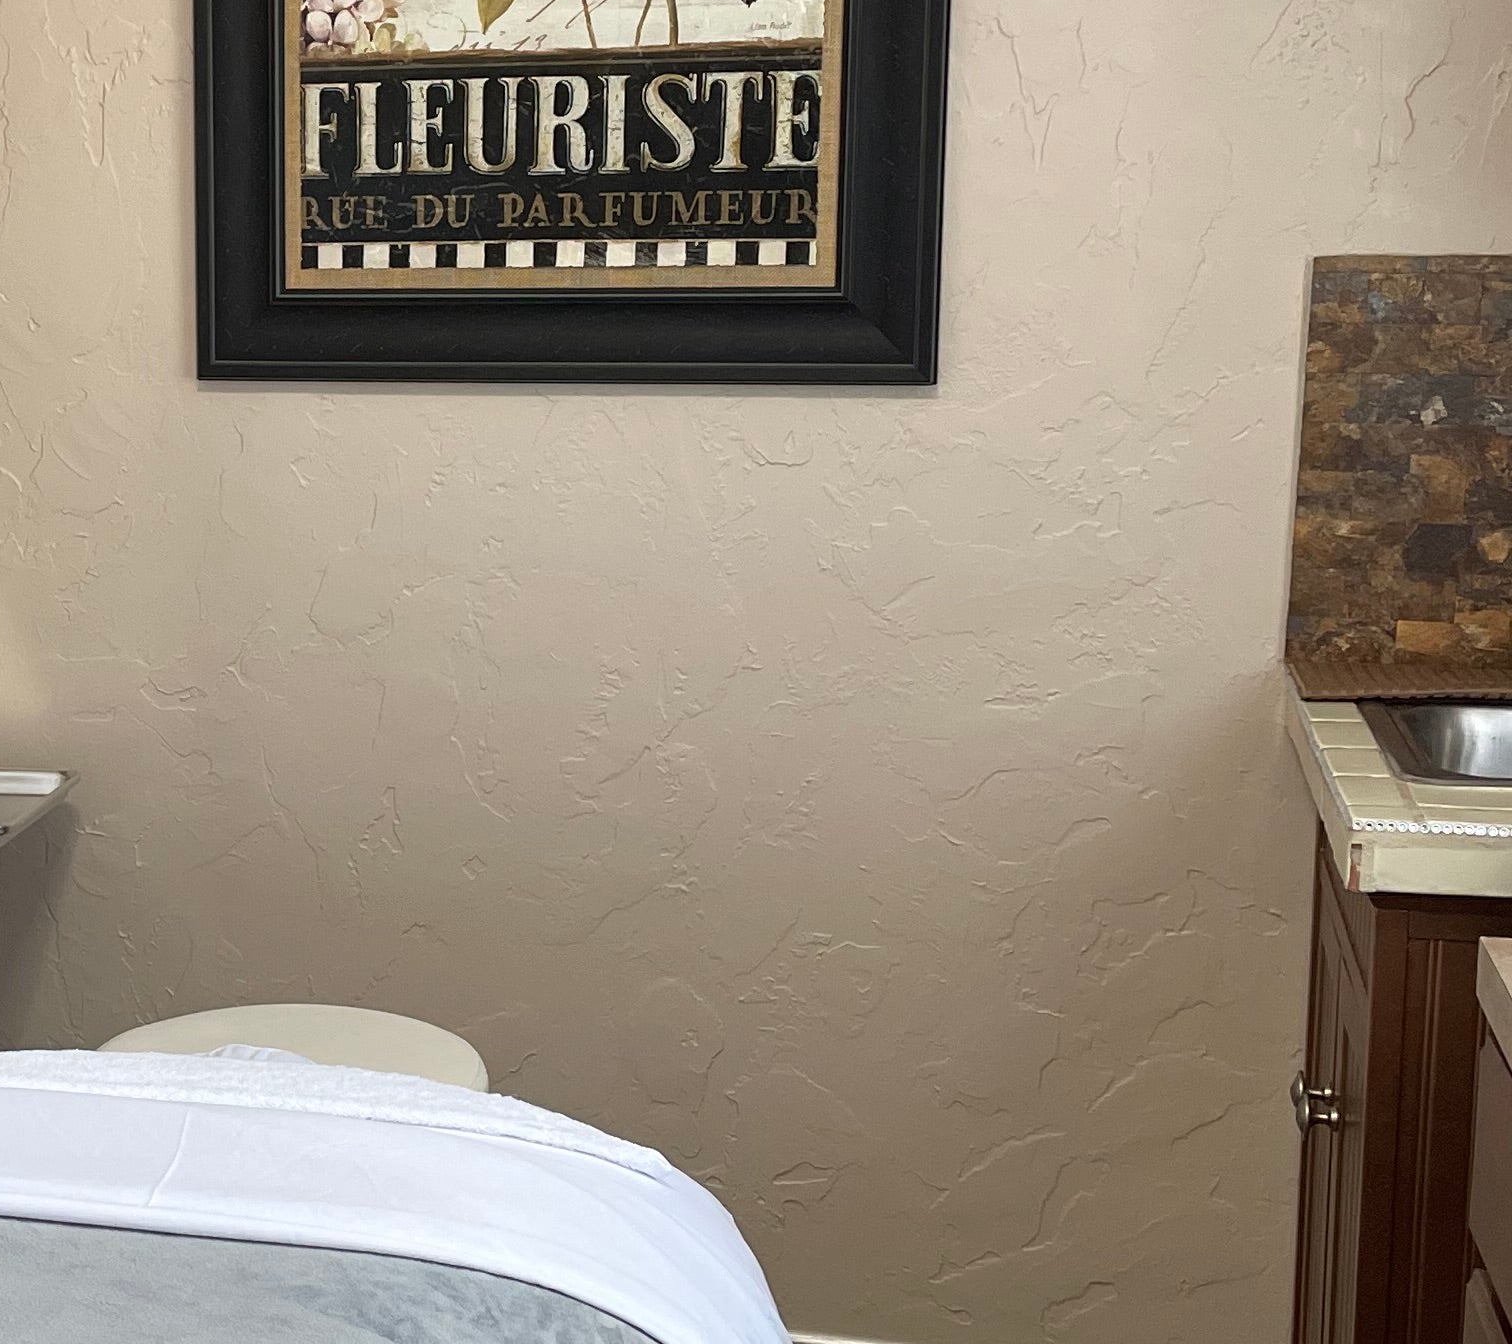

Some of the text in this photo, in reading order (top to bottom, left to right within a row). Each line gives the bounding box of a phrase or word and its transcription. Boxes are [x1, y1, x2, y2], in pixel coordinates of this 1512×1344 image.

[300, 69, 822, 180] FLEURISTE
[301, 188, 818, 232] RUE DU PARFUMEUR
